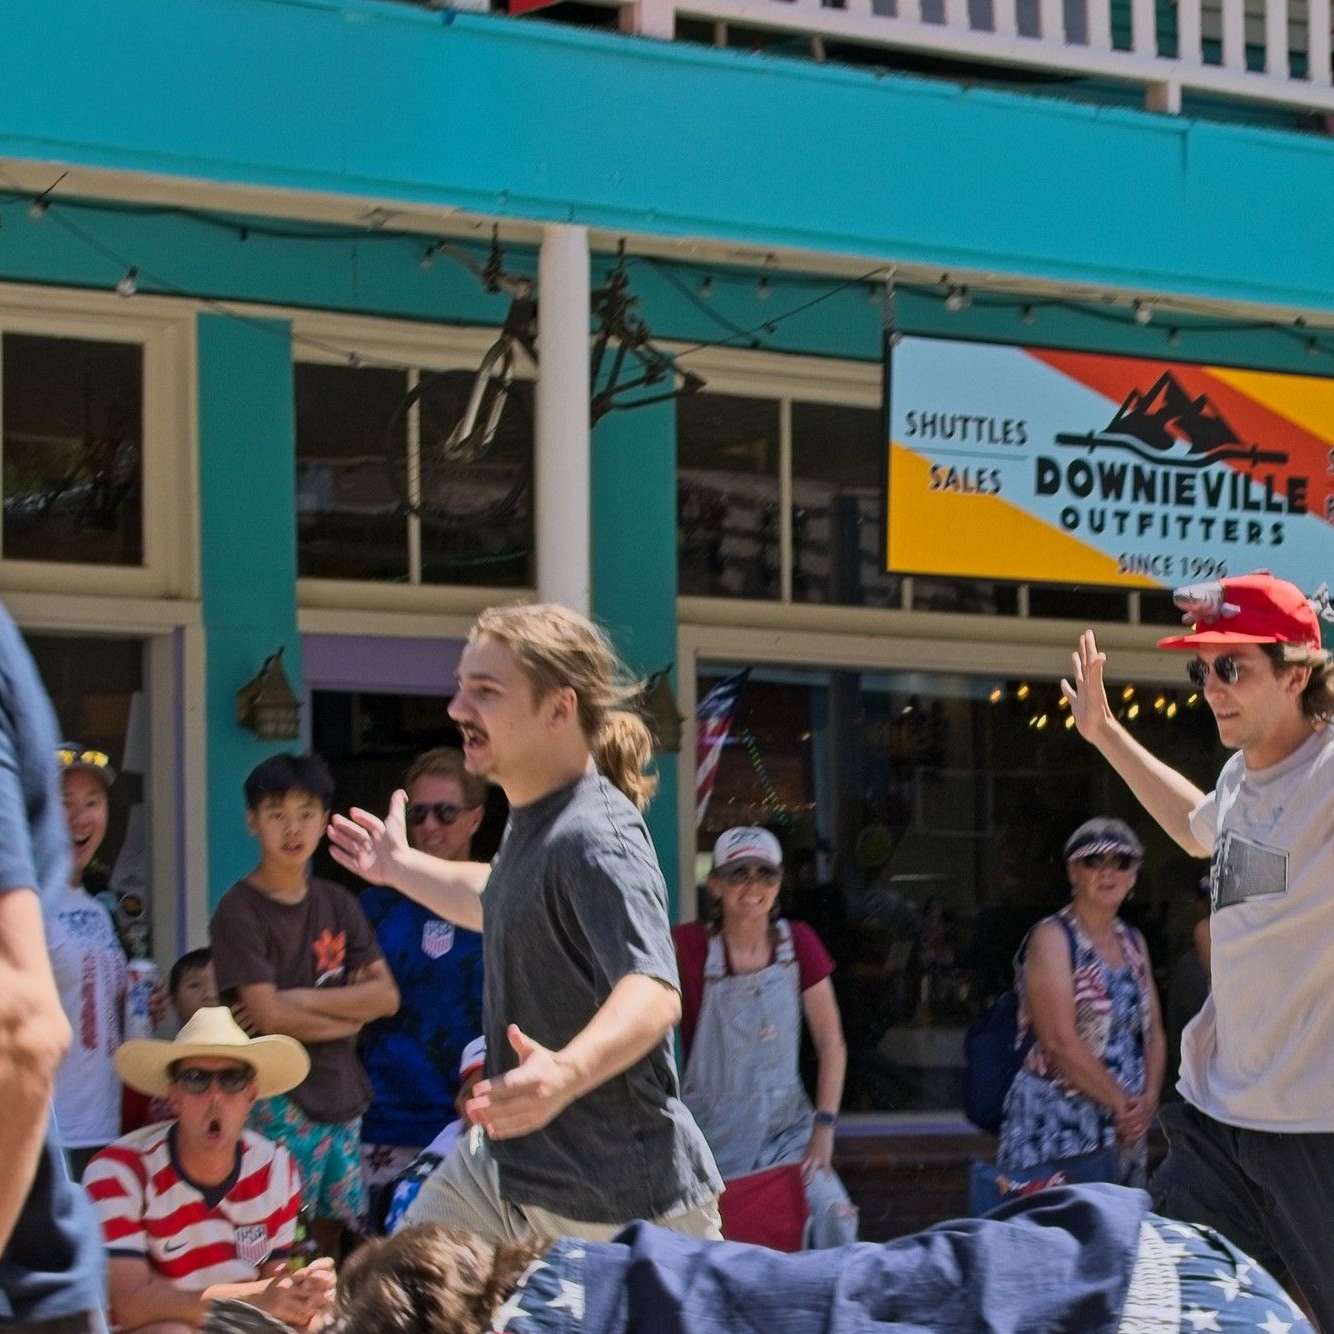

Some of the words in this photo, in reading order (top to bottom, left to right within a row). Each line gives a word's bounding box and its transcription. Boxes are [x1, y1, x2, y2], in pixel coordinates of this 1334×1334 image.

[904, 409, 1028, 447] SHUTTLES
[927, 464, 1002, 496] SALES
[1034, 455, 1308, 515] DOWNIEVILLE
[1059, 505, 1286, 547] OUTFITTERS
[1116, 552, 1175, 579] SINCE
[1178, 555, 1228, 581] 1996
